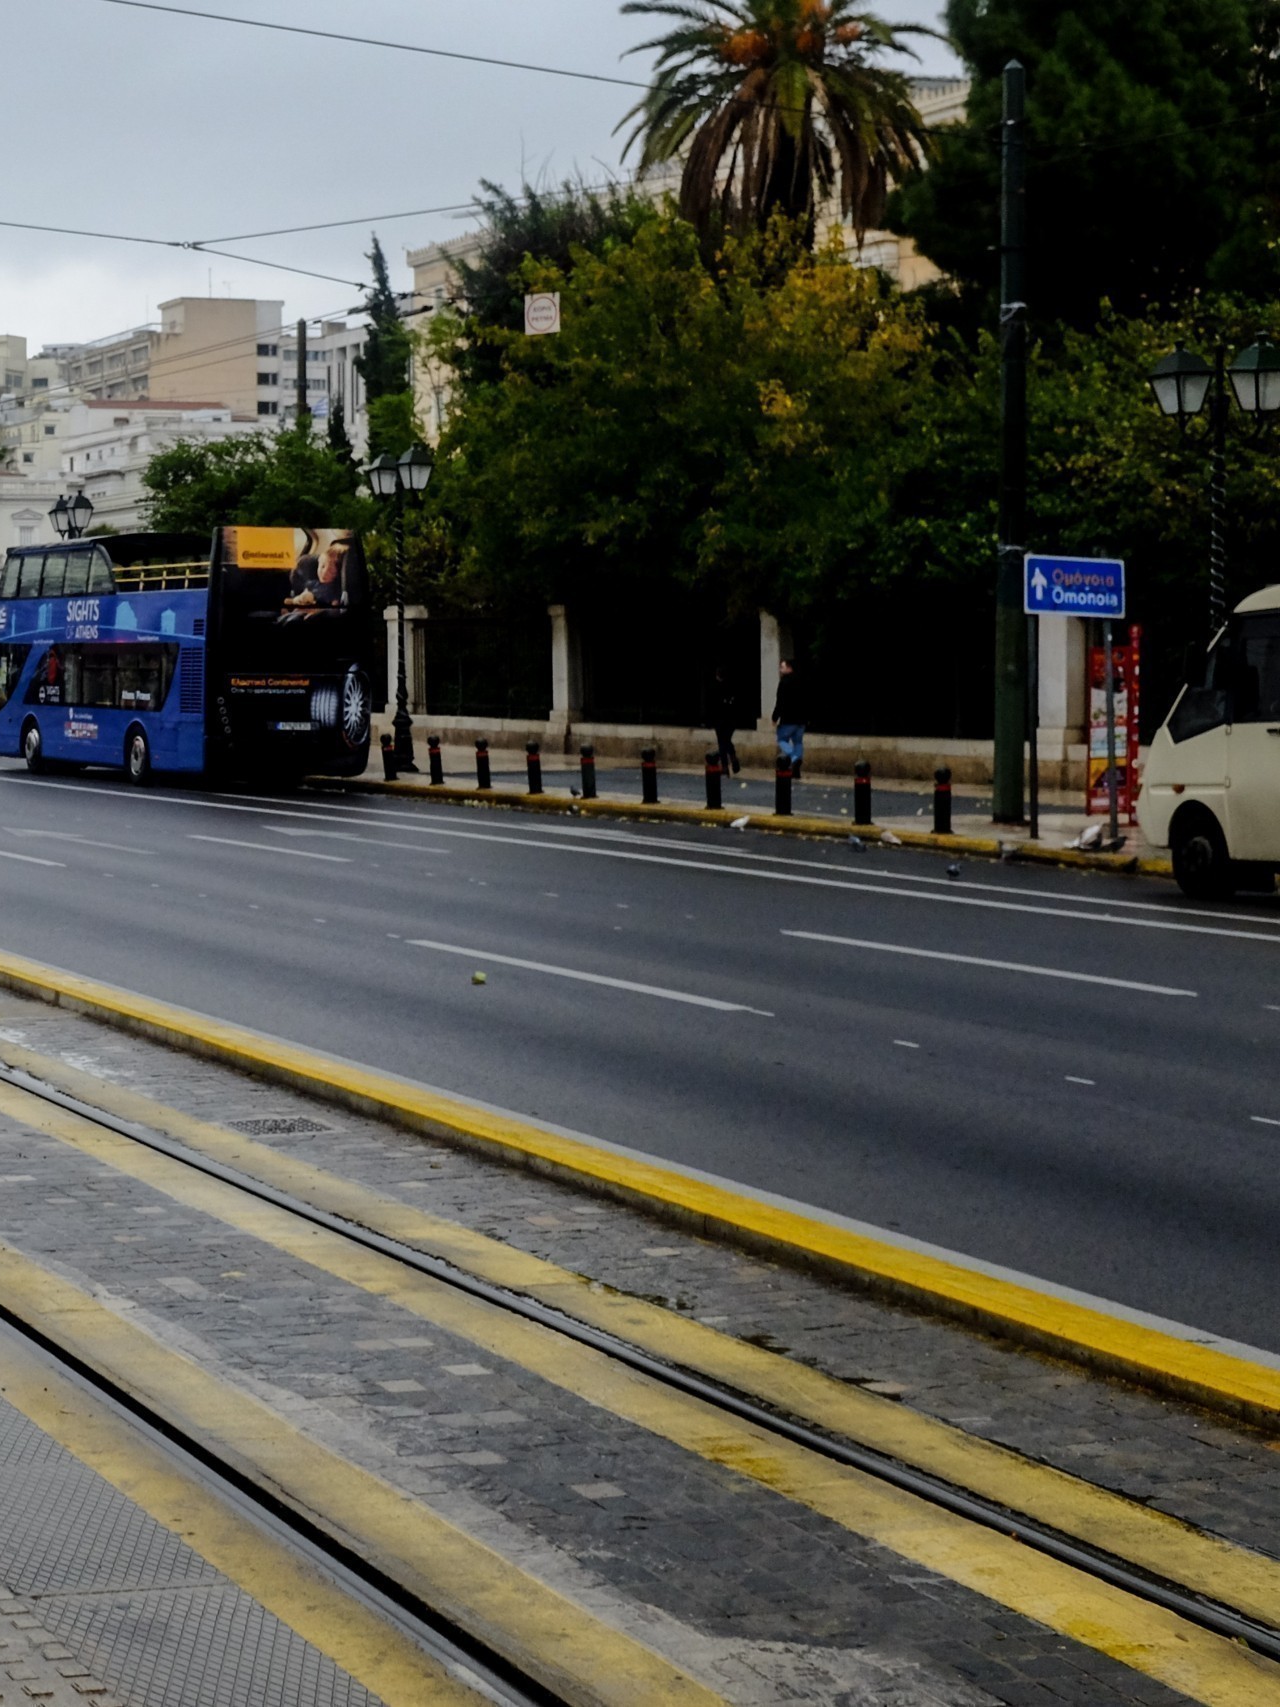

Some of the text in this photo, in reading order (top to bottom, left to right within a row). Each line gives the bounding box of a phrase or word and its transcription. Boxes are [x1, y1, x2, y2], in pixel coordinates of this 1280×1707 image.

[241, 550, 284, 560] Continental
[1052, 586, 1118, 607] Omonoia
[66, 599, 100, 622] SIGHTS
[75, 625, 99, 639] ATHENS
[267, 678, 310, 687] Continental
